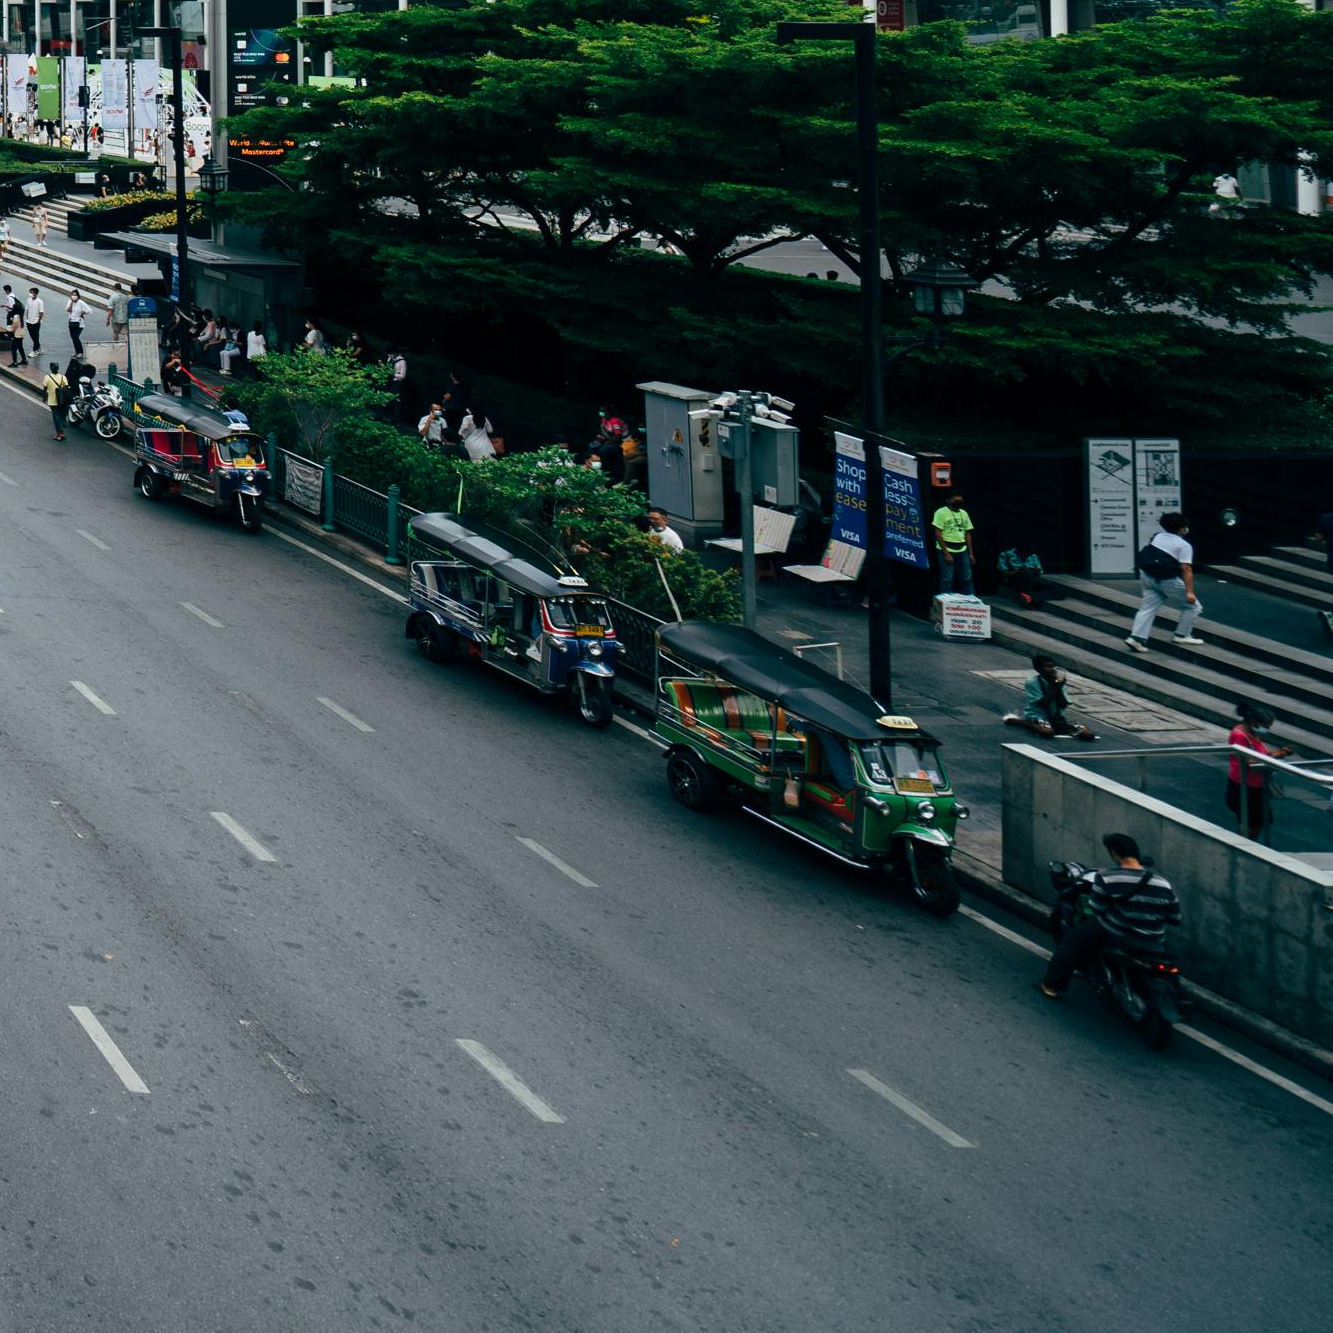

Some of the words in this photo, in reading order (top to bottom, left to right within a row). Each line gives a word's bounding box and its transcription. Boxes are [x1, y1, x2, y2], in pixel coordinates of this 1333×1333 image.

[837, 458, 867, 482] Shop
[836, 476, 861, 495] with
[884, 473, 914, 495] Cash
[836, 491, 868, 512] ease
[884, 486, 909, 507] less
[885, 502, 907, 521] pay
[840, 527, 861, 544] VISA
[885, 517, 922, 539] ment
[885, 530, 924, 549] preferred
[894, 546, 918, 563] VISA
